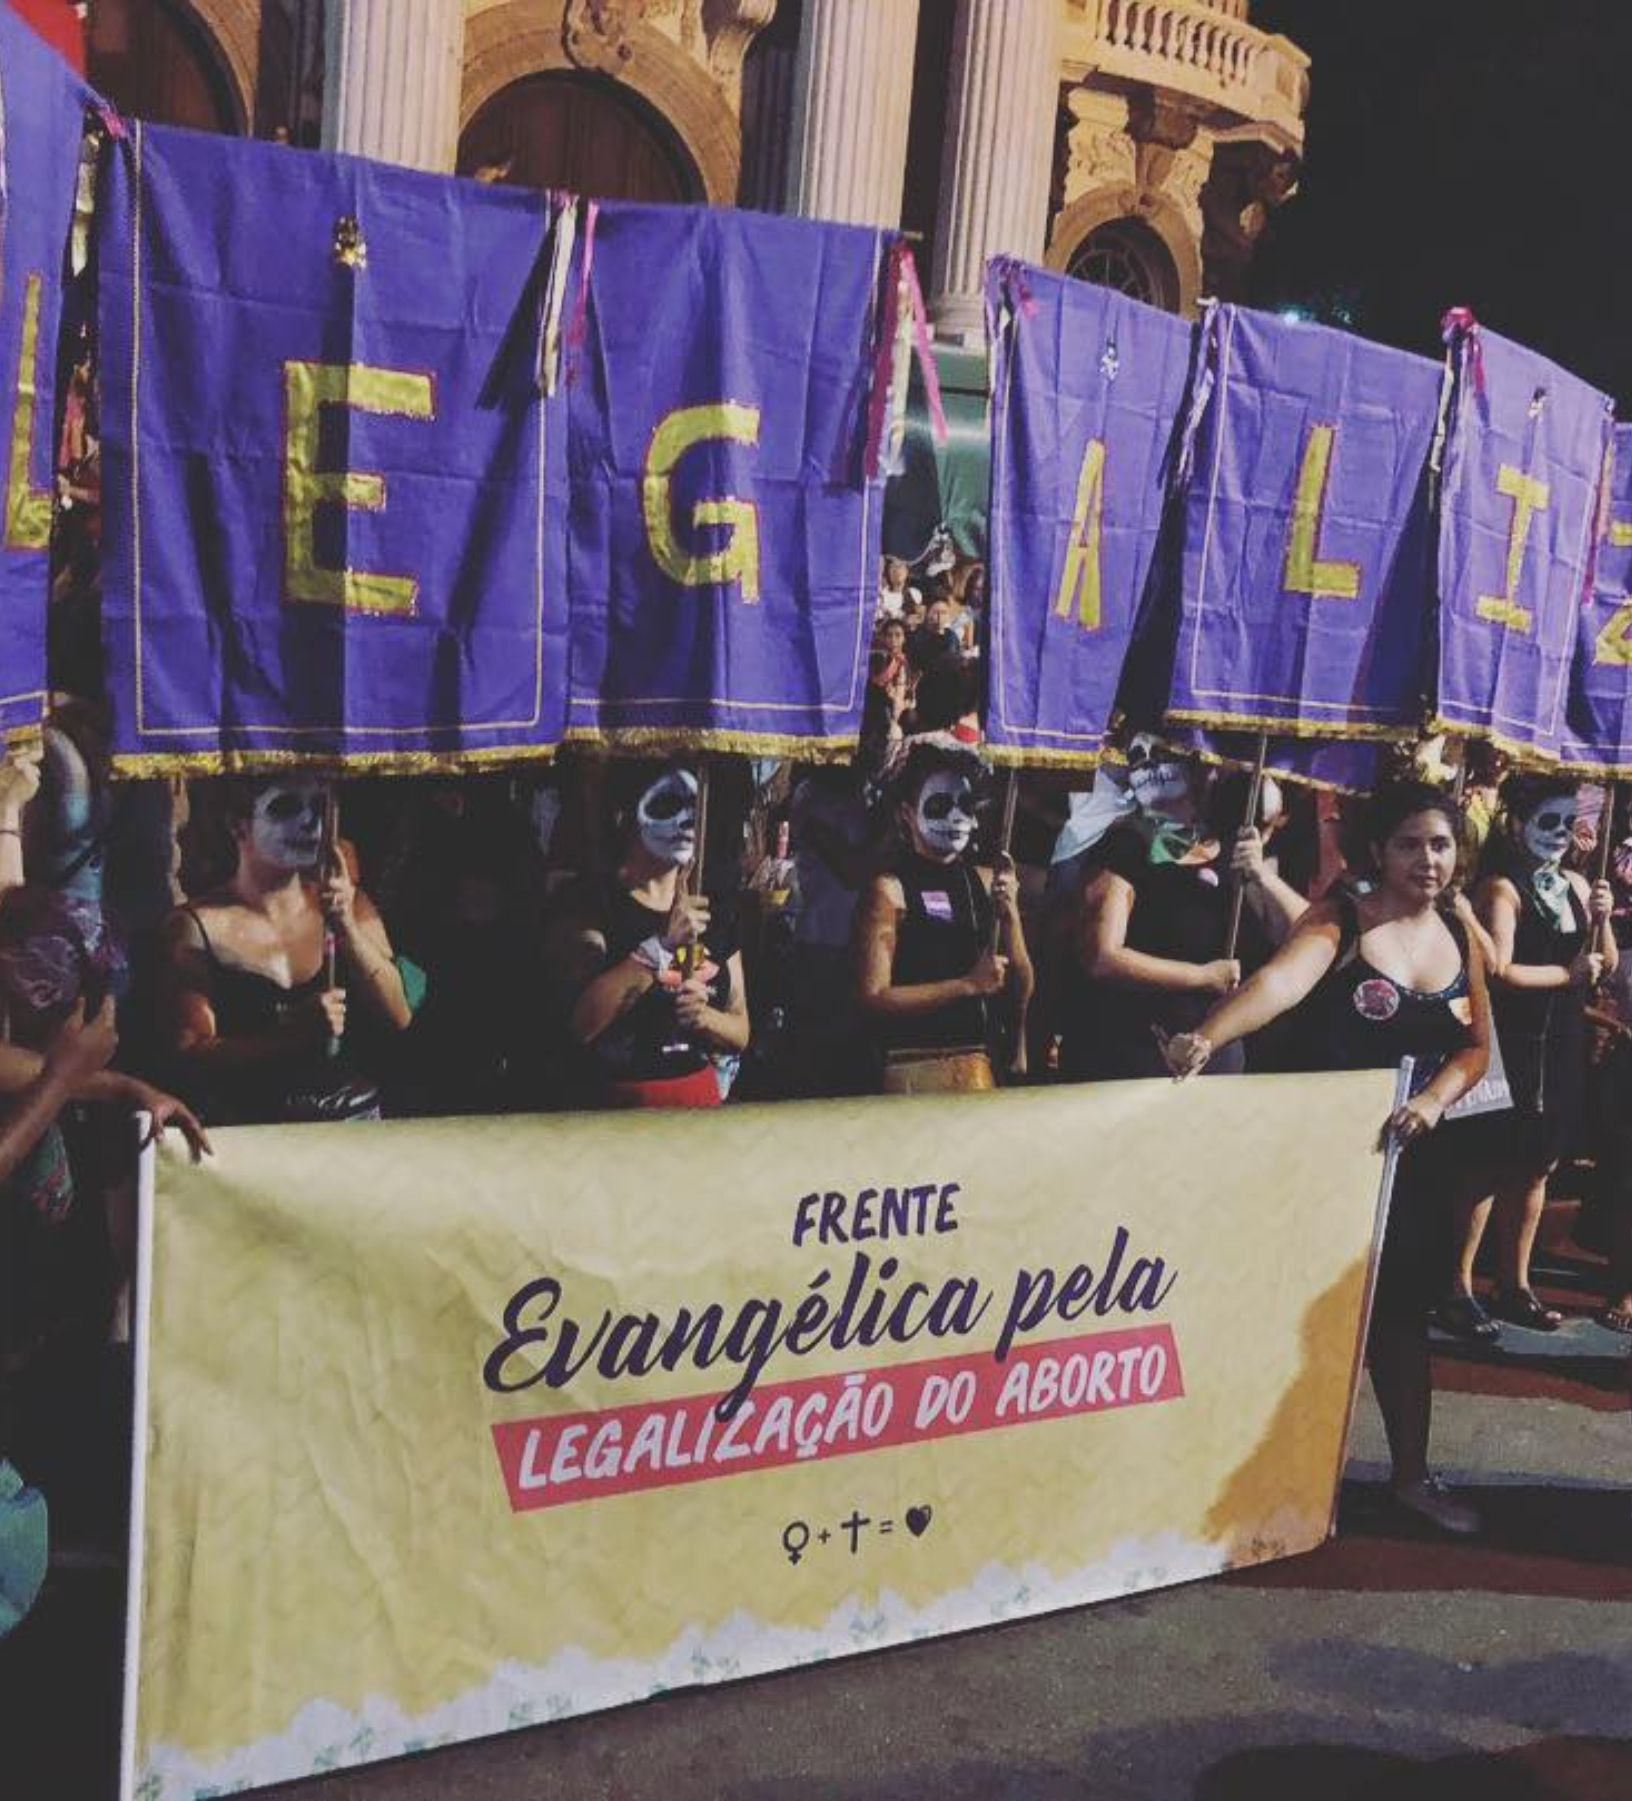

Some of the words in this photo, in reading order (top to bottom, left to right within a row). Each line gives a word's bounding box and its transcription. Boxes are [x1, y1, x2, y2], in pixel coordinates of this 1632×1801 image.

[792, 1183, 961, 1247] FRENTE
[482, 1250, 996, 1423] Evangélica
[993, 1225, 1180, 1363] pela
[516, 1373, 893, 1490] LEGALIZAÇÃO
[912, 1371, 977, 1430] DO
[995, 1344, 1167, 1418] ABORTO
